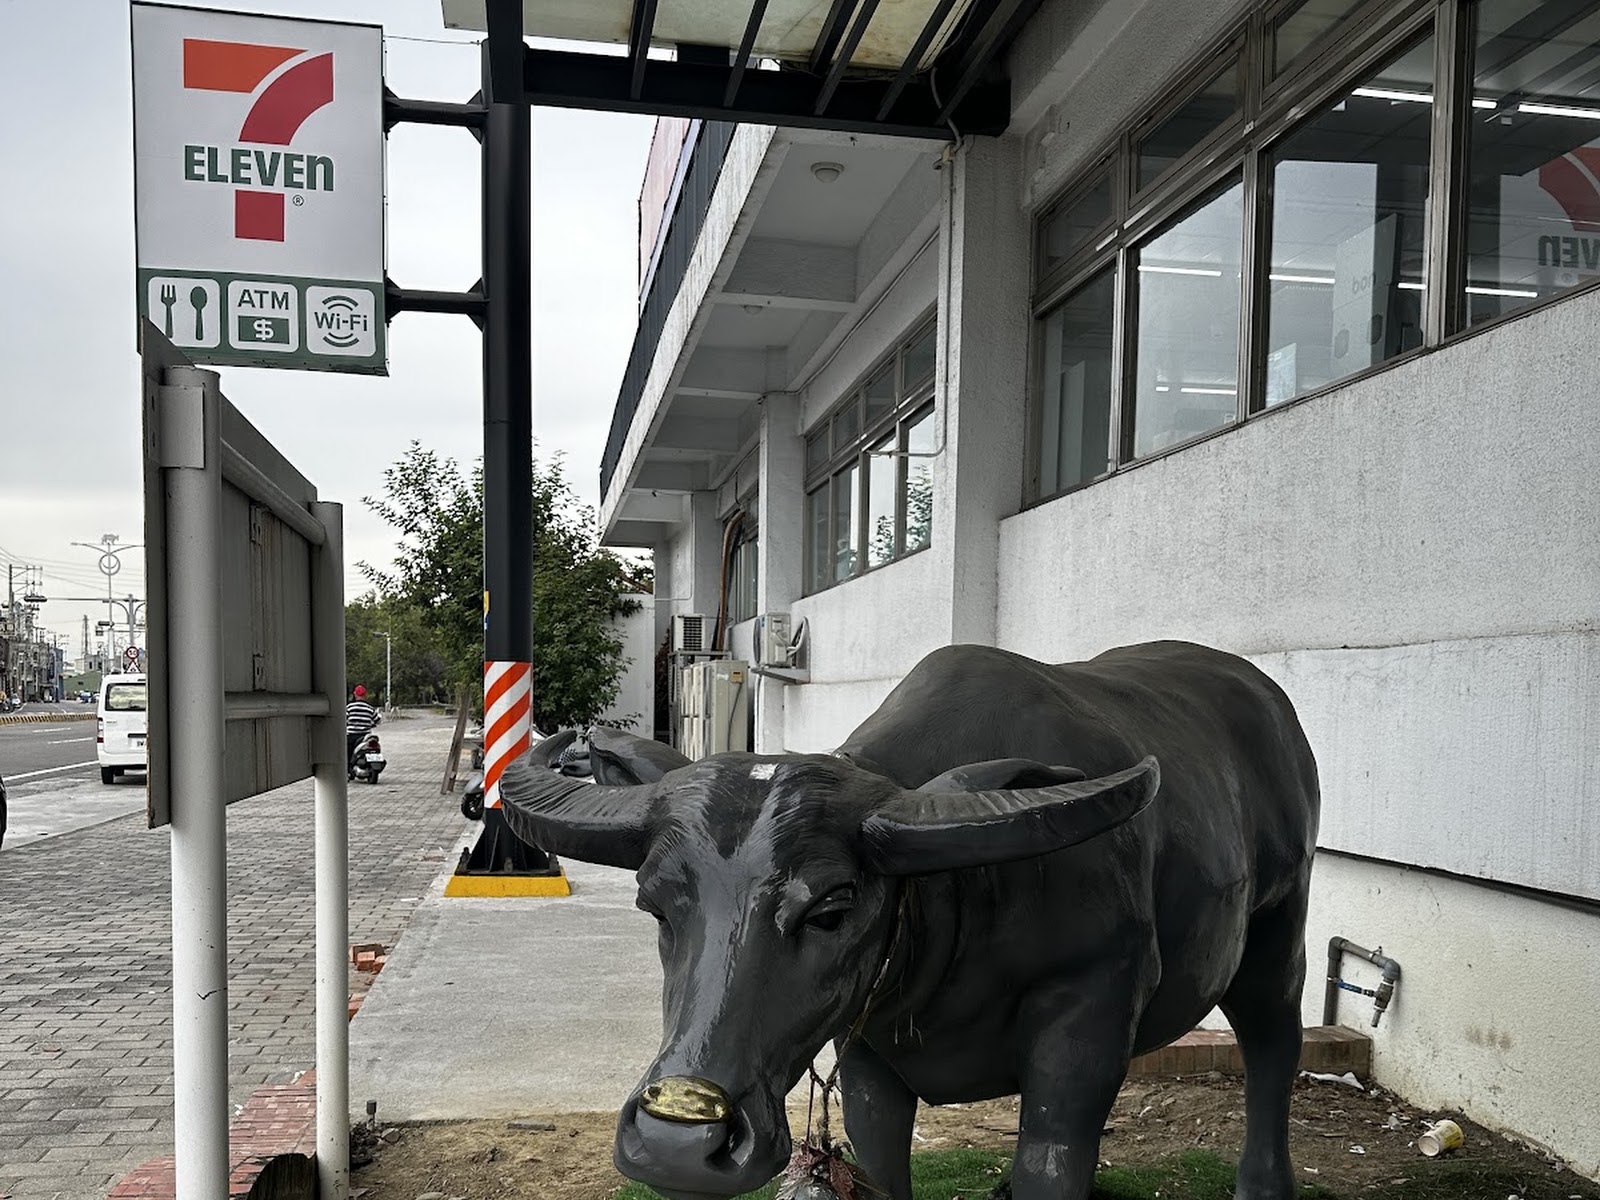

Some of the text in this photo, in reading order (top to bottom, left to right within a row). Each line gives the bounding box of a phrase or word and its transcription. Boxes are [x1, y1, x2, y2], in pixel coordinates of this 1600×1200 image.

[184, 145, 334, 191] ELEVEn
[237, 289, 290, 311] ATM
[314, 311, 368, 332] Wi-Fi
